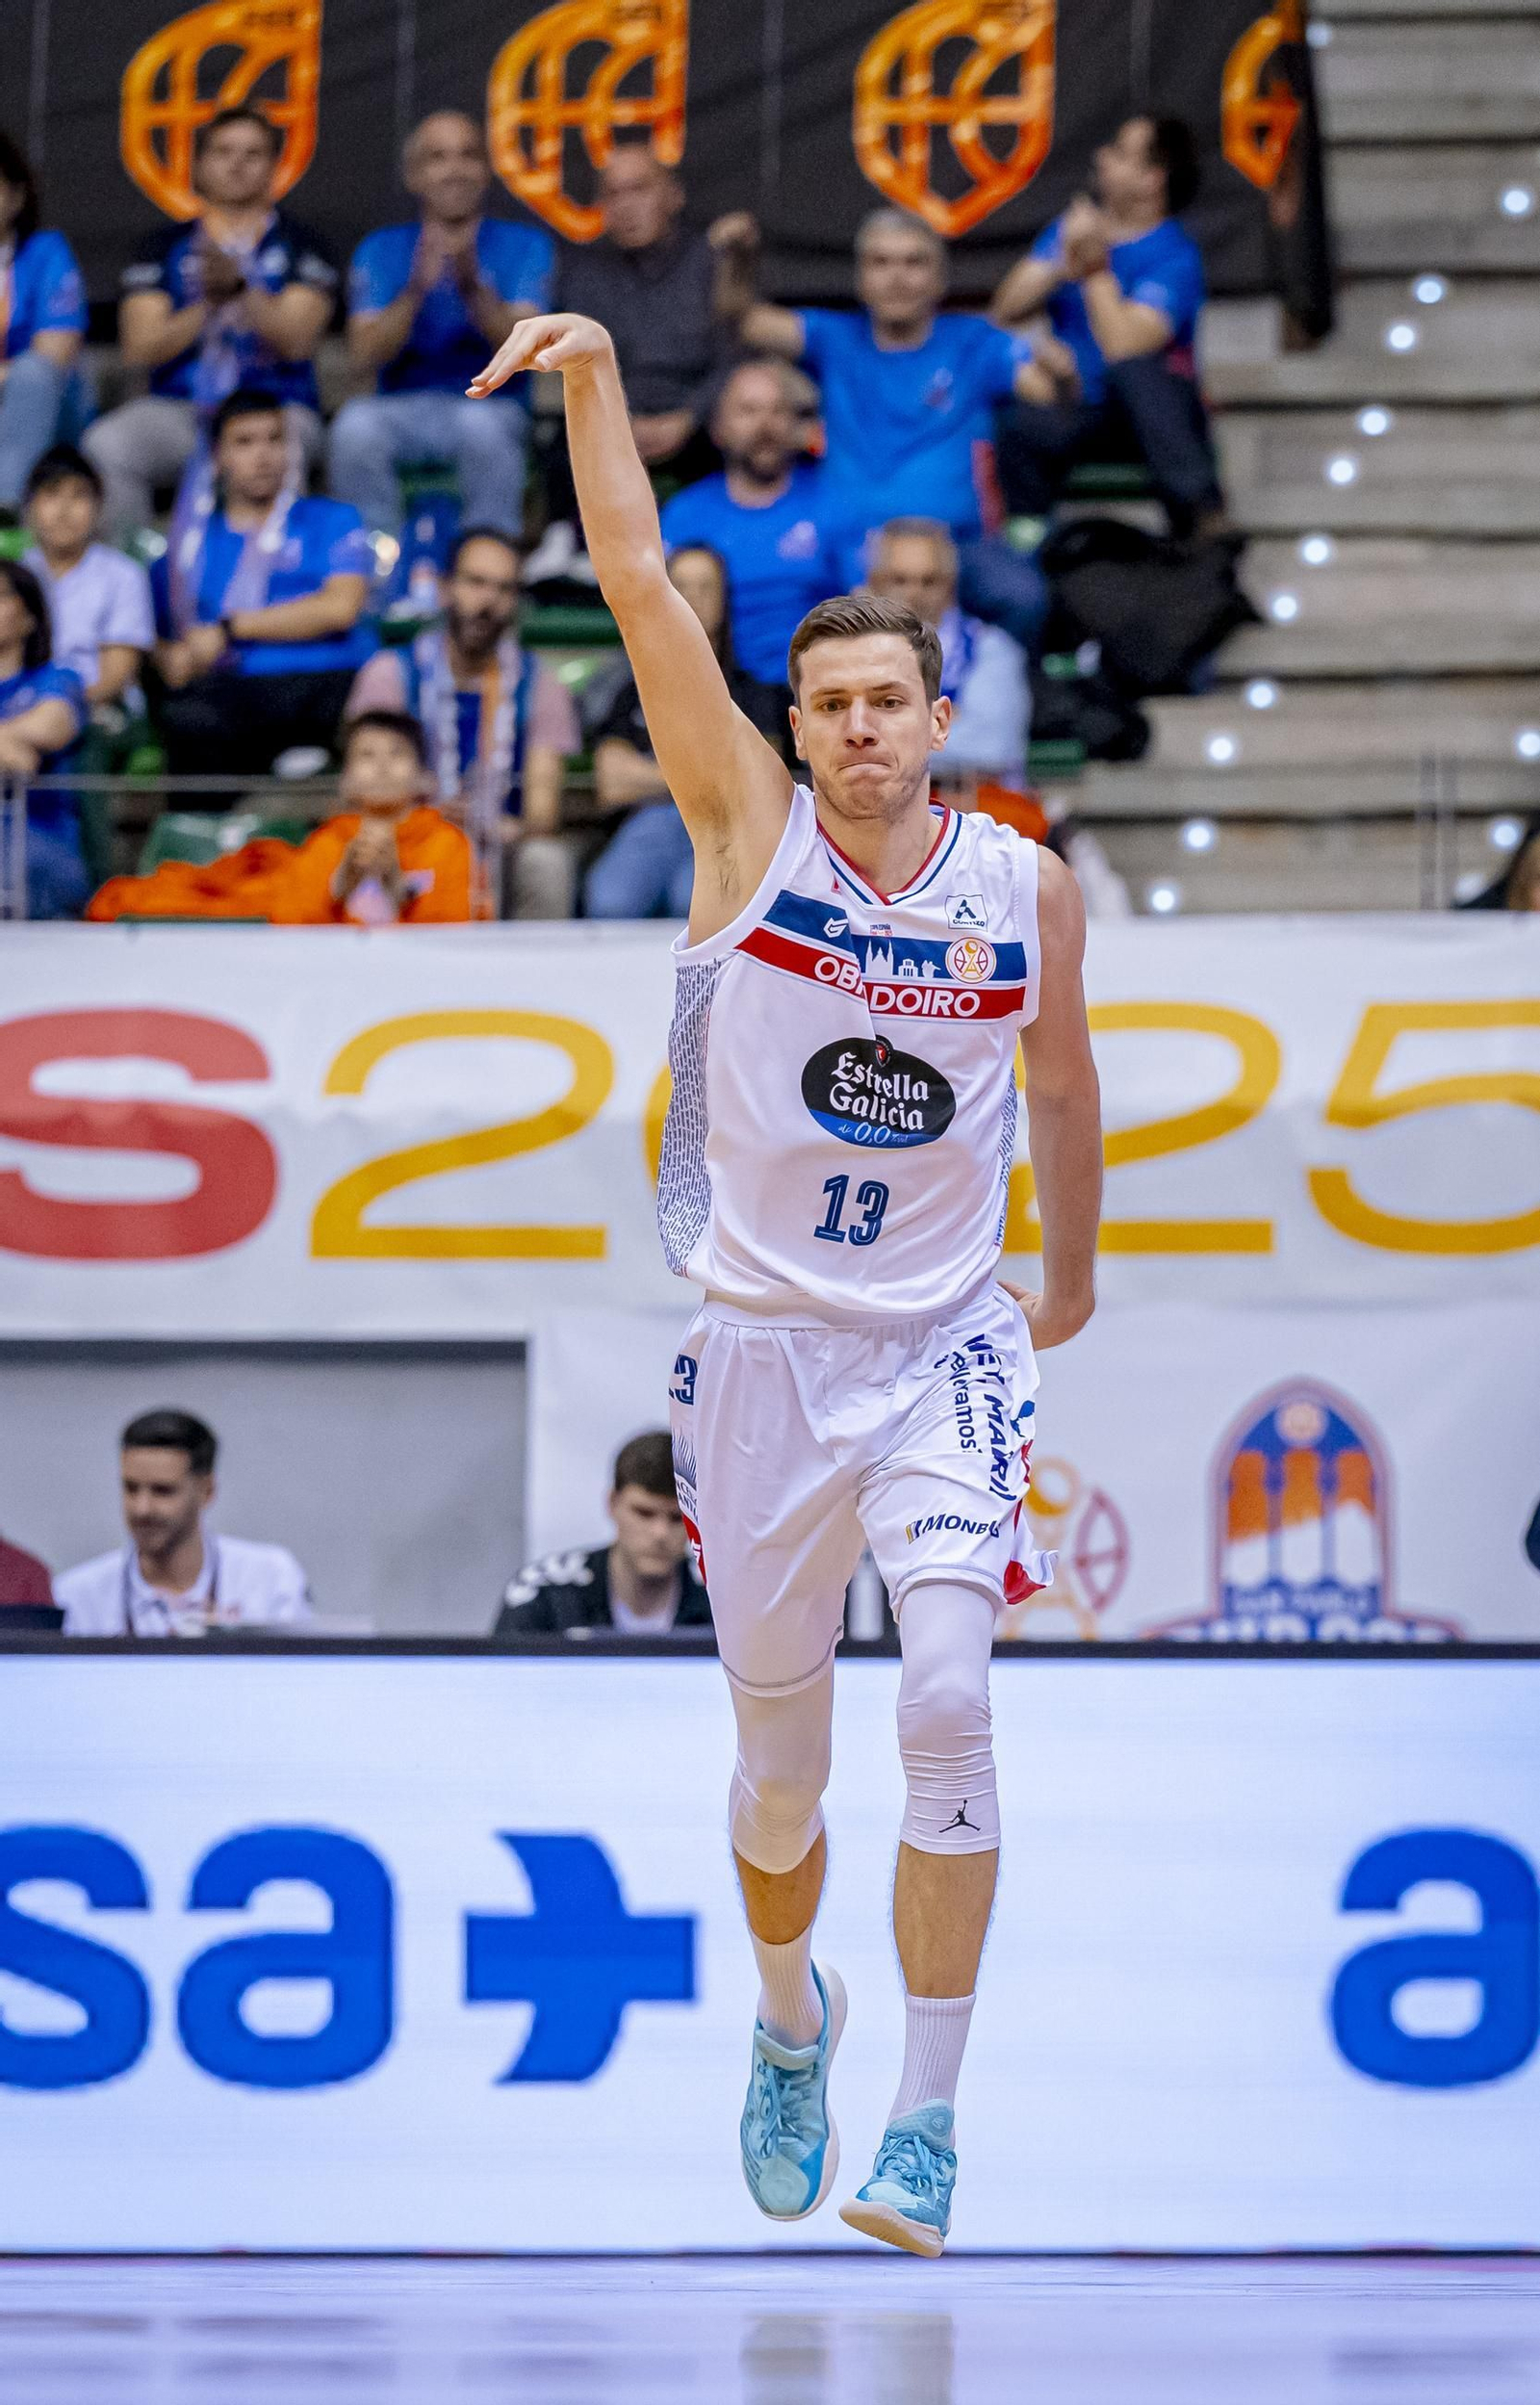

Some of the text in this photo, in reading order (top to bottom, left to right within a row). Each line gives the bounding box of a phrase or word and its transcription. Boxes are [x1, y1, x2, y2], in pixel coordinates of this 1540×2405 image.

[814, 956, 981, 1018] OBDOIRO
[831, 1051, 930, 1101] Estrella
[829, 1081, 924, 1130] Galicia
[813, 1174, 890, 1246] 13
[668, 1354, 698, 1406] 3
